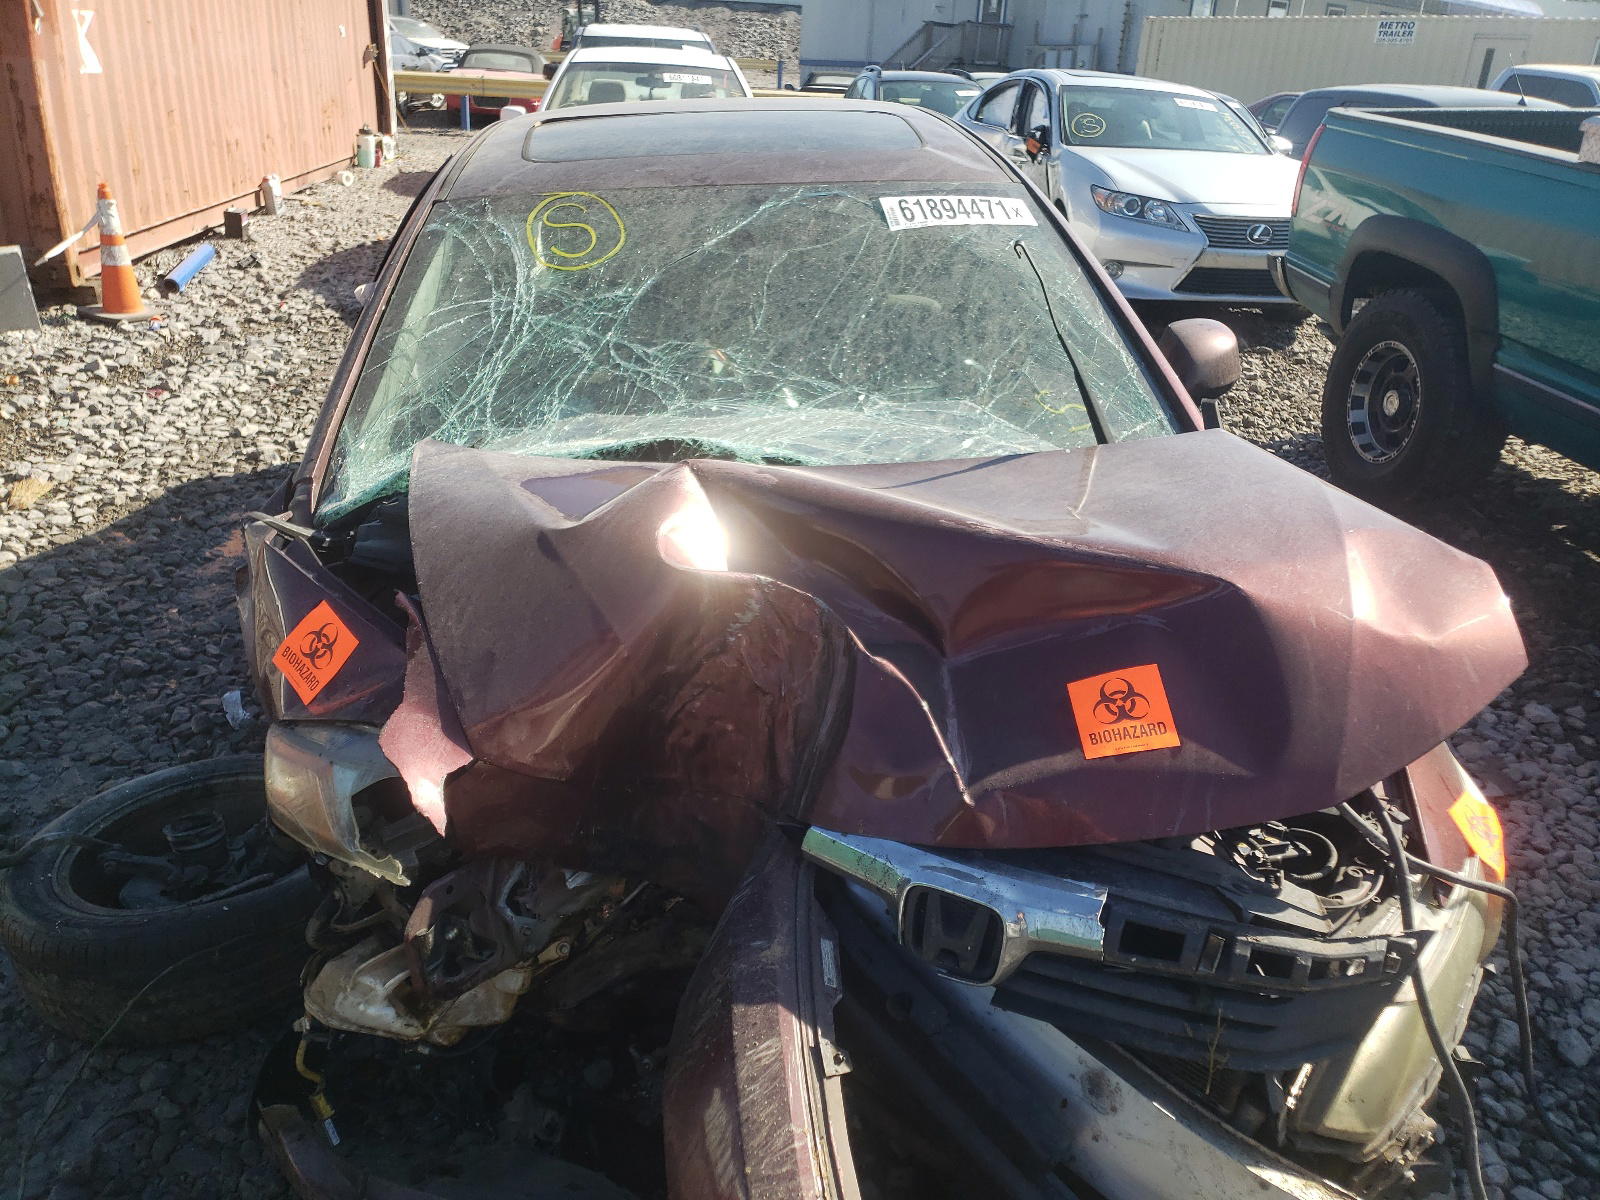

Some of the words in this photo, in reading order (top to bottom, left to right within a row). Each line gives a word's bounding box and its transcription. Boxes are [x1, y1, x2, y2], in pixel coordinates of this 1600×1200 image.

[1378, 21, 1416, 29] METRO
[897, 198, 1012, 223] 61894471
[542, 203, 597, 258] S
[281, 646, 320, 691] BIOHAZARD
[1088, 721, 1168, 746] BIOHAZARD
